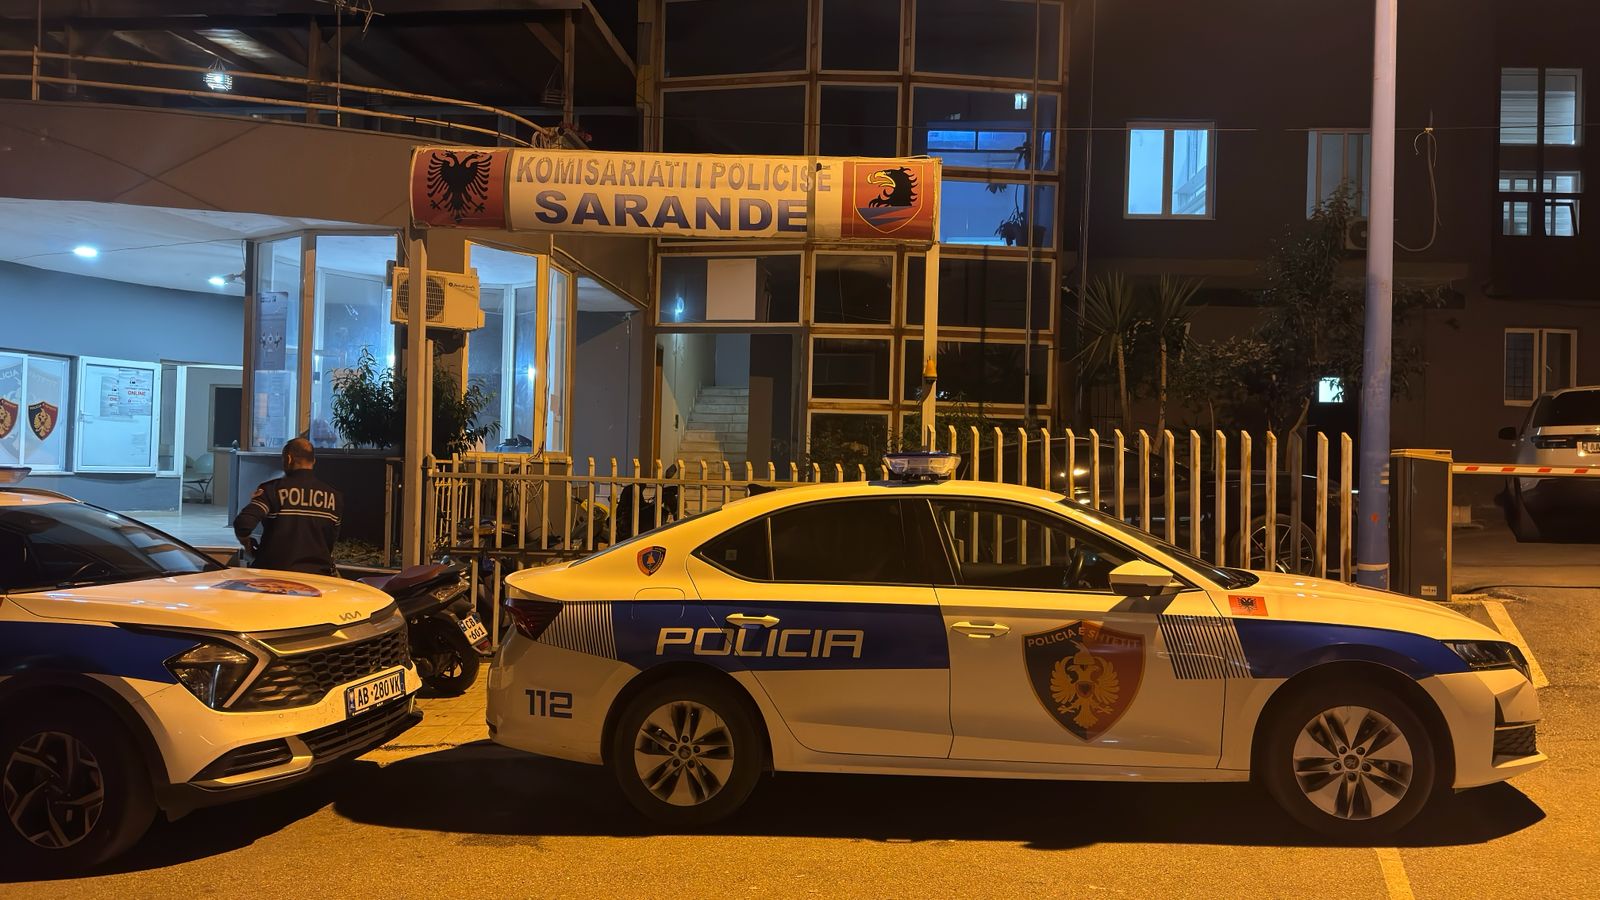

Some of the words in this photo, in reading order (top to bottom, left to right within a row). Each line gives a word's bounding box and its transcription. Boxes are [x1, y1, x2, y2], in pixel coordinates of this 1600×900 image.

[516, 156, 688, 188] KOMISARIATI
[694, 162, 703, 188] I
[534, 190, 808, 232] SARANDE
[278, 488, 336, 511] POLICIA
[465, 618, 476, 629] CB
[471, 627, 485, 640] 601
[1027, 628, 1077, 647] POLICIA
[1078, 626, 1086, 636] E
[656, 627, 864, 658] POLICIA
[358, 686, 369, 707] AB
[373, 679, 390, 701] 280
[389, 675, 401, 694] VK
[525, 688, 573, 719] 112
